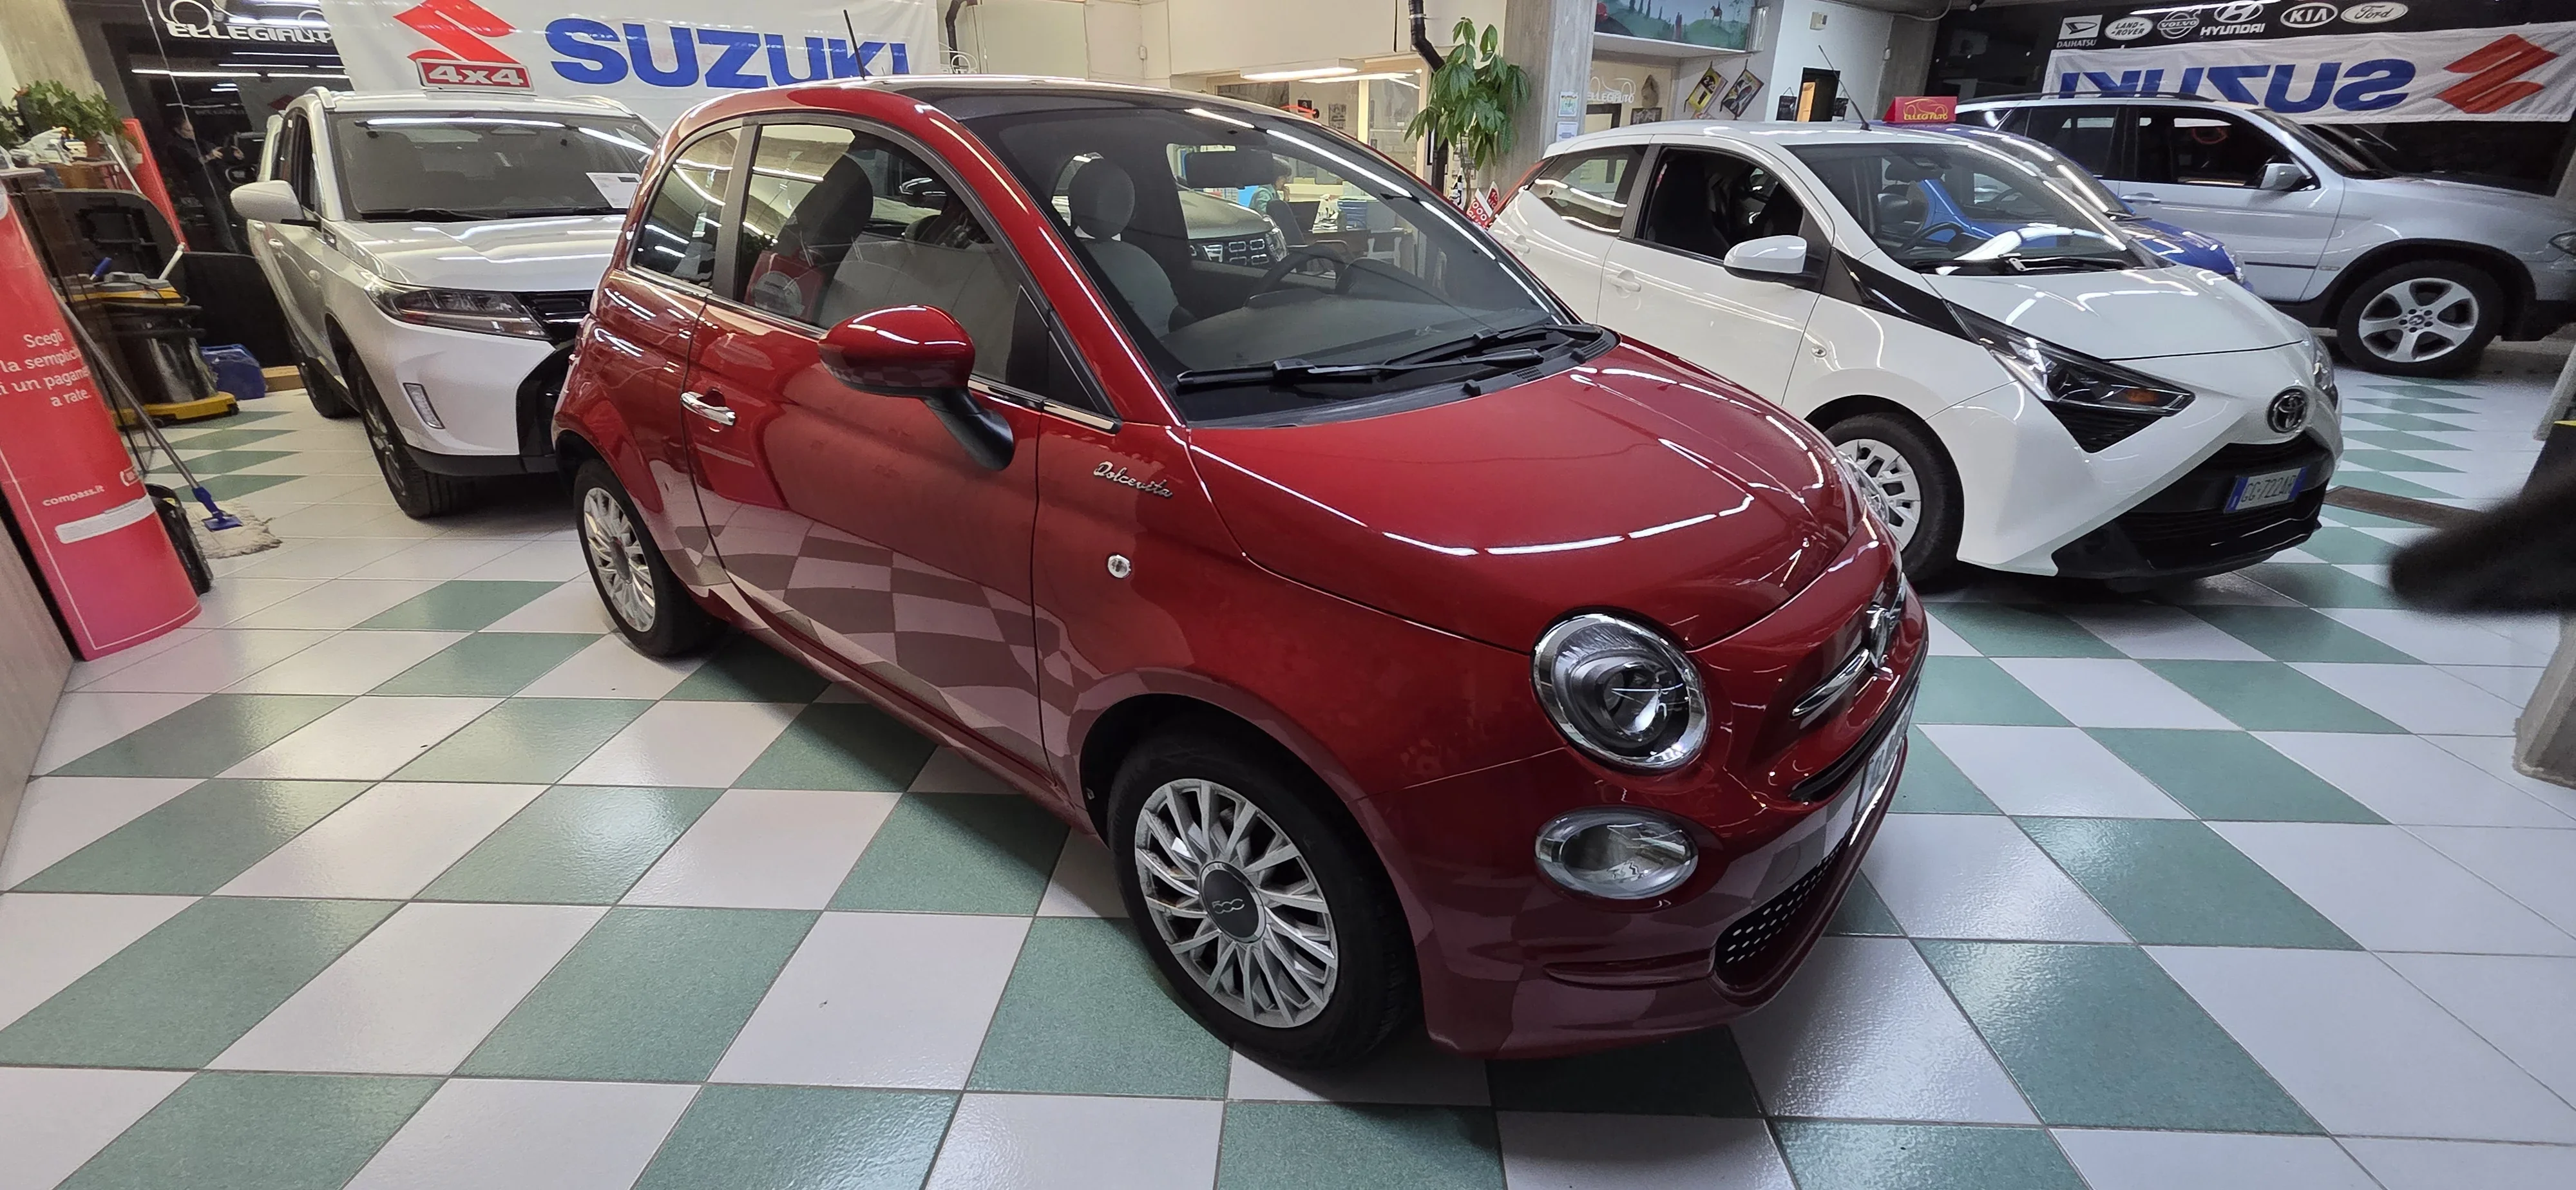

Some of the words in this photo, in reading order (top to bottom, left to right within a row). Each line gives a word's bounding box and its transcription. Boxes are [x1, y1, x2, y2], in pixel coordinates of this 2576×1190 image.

[2289, 9, 2327, 23] KIA
[2354, 5, 2392, 19] Ford
[2115, 21, 2137, 30] LAND
[2115, 28, 2144, 36] ROVER
[2200, 23, 2266, 35] HYUNDAI
[166, 23, 331, 44] ELLEGIAUT
[2056, 39, 2097, 48] DAIHATSU
[545, 18, 910, 88] SUZUKI
[428, 65, 524, 86] 4x4
[23, 329, 65, 348] Scegli
[11, 378, 41, 392] un
[50, 395, 62, 407] a
[63, 389, 91, 404] rate.
[1093, 460, 1173, 498] Dolcevita
[1212, 898, 1245, 914] 500
